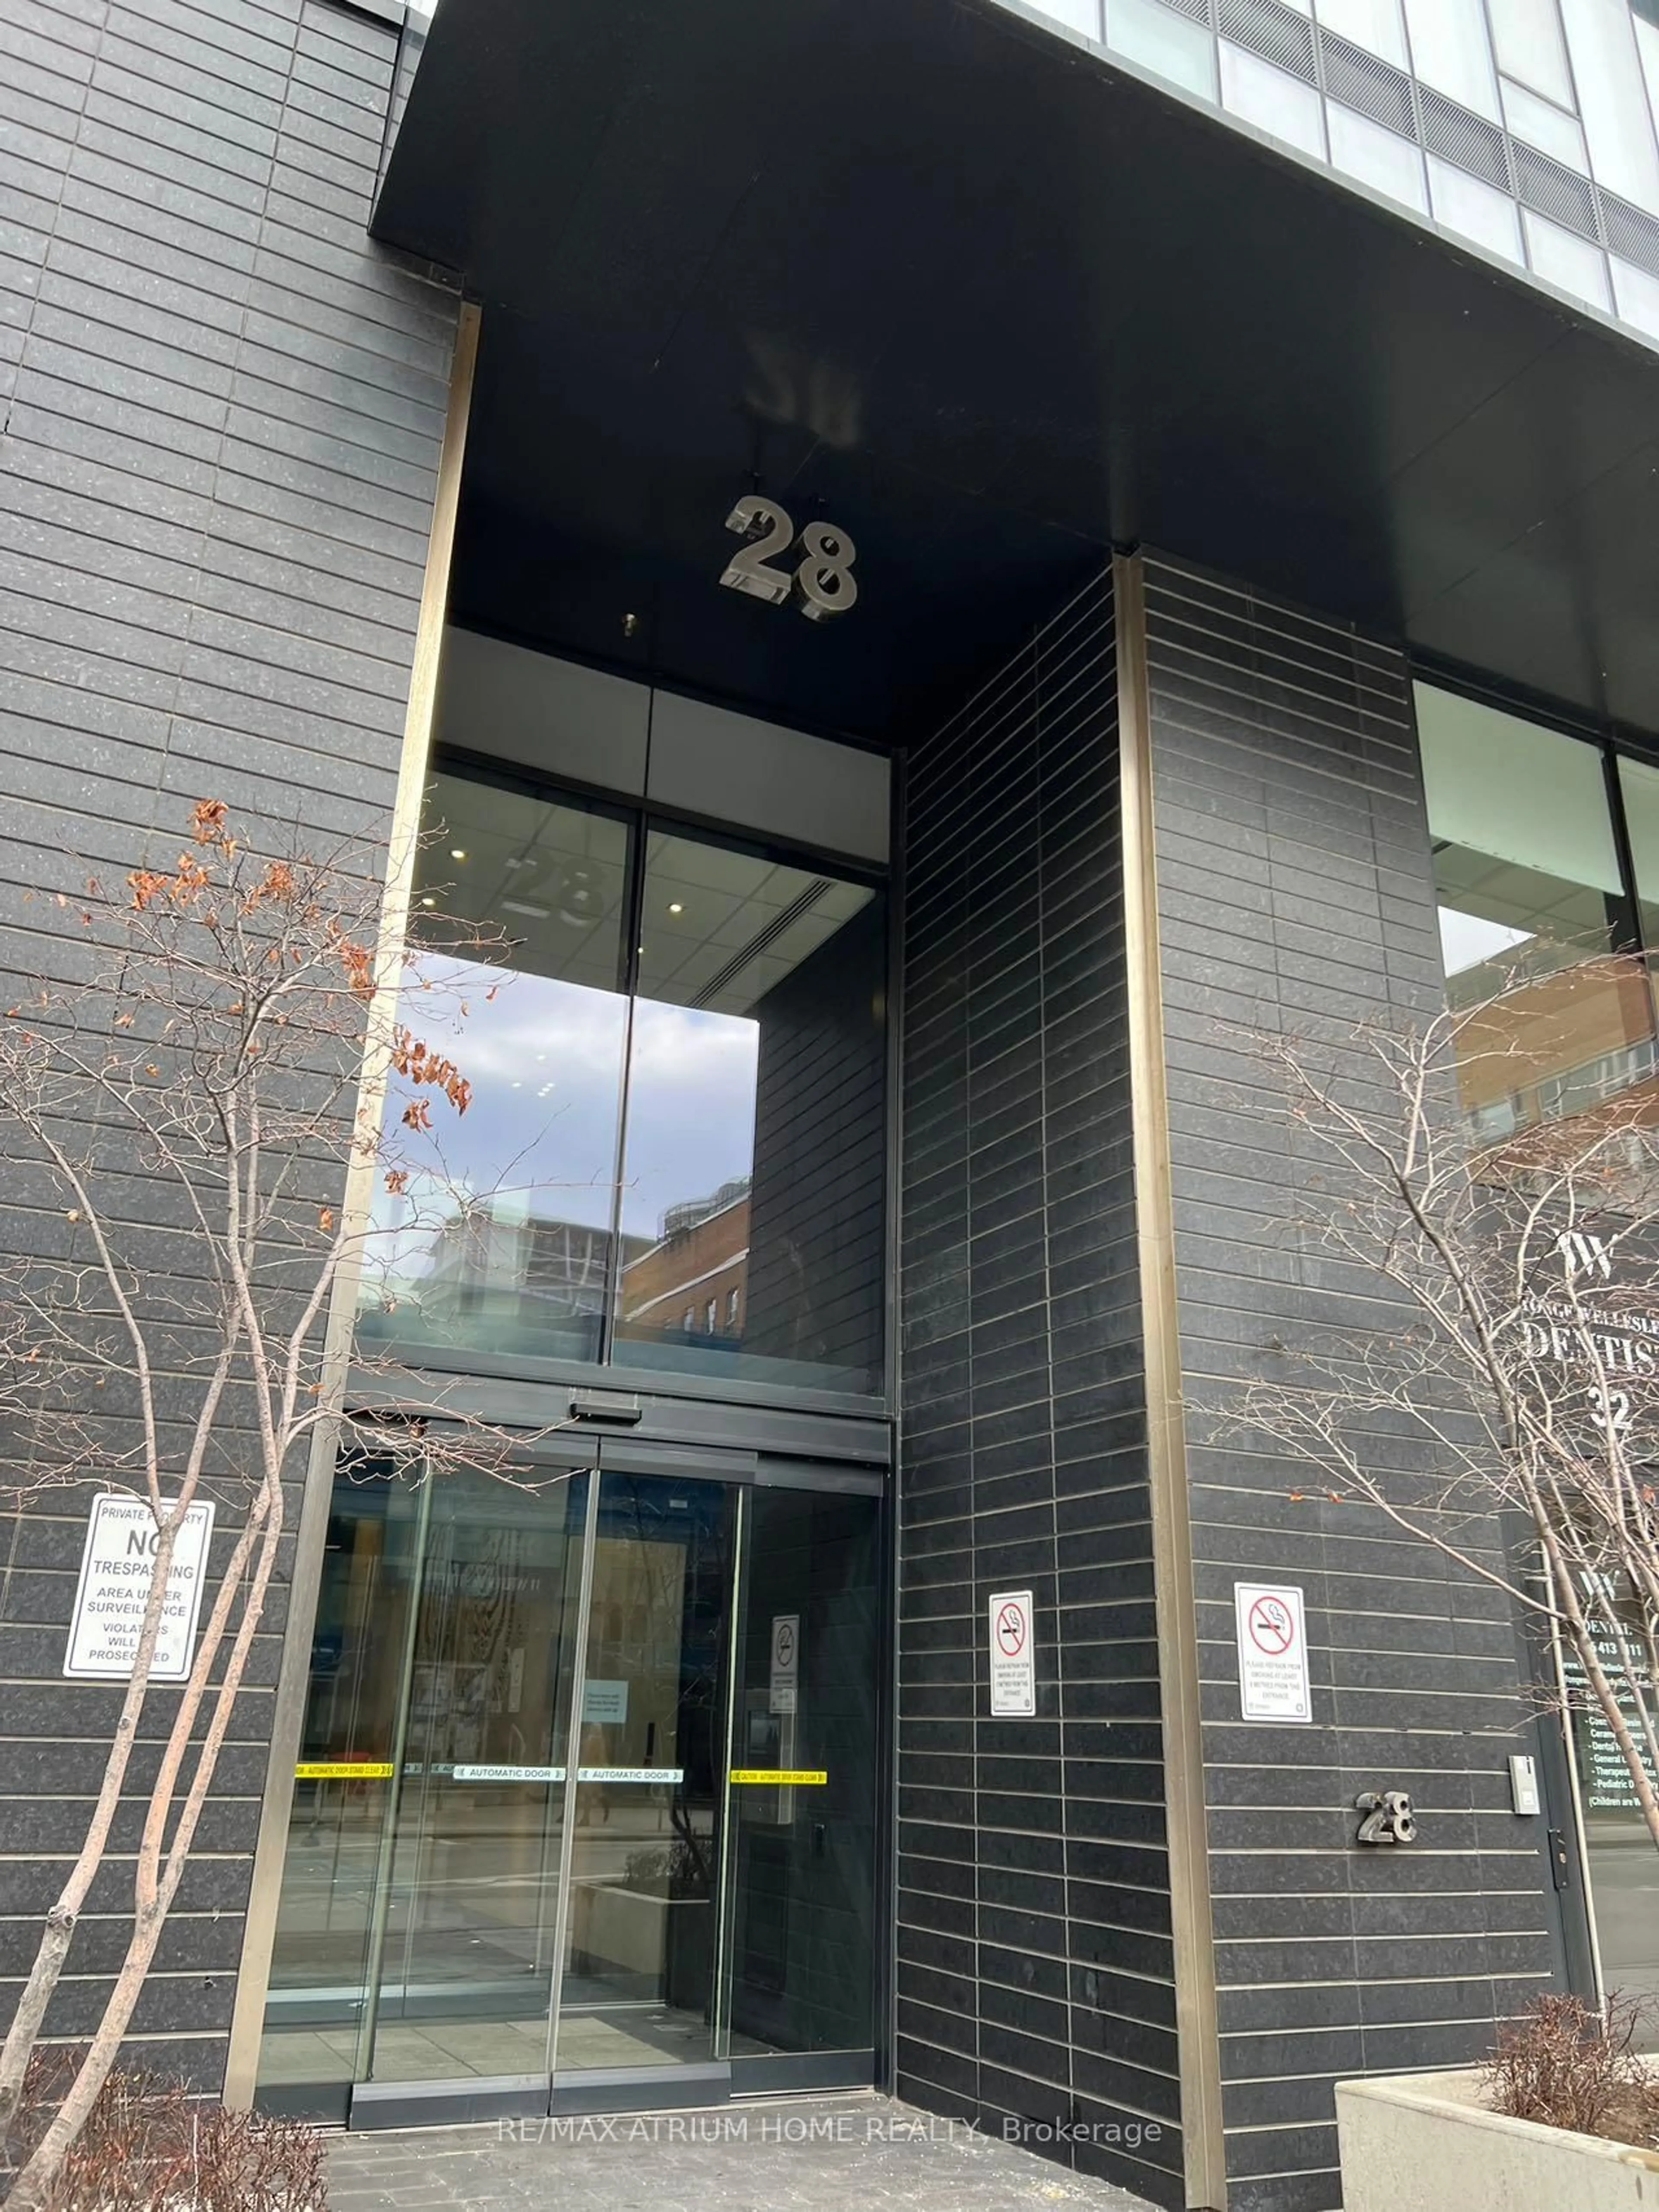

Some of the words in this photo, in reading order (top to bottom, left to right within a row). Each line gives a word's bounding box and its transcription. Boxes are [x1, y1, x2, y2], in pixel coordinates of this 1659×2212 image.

[719, 495, 857, 622] 28
[101, 1507, 144, 1520] PRIVATE
[147, 1511, 203, 1524] PORTY
[94, 1560, 194, 1579] TRESPAING
[97, 1587, 133, 1599] AREA
[137, 1589, 181, 1601] UER
[87, 1602, 187, 1616] SURVEILNCE
[104, 1623, 168, 1634] VIOLATS
[108, 1637, 136, 1647] WILL
[89, 1650, 169, 1662] PROSECED
[470, 1769, 522, 1777] AUTOMATIC
[525, 1769, 550, 1777] DOOR
[1356, 1791, 1417, 1842] 28
